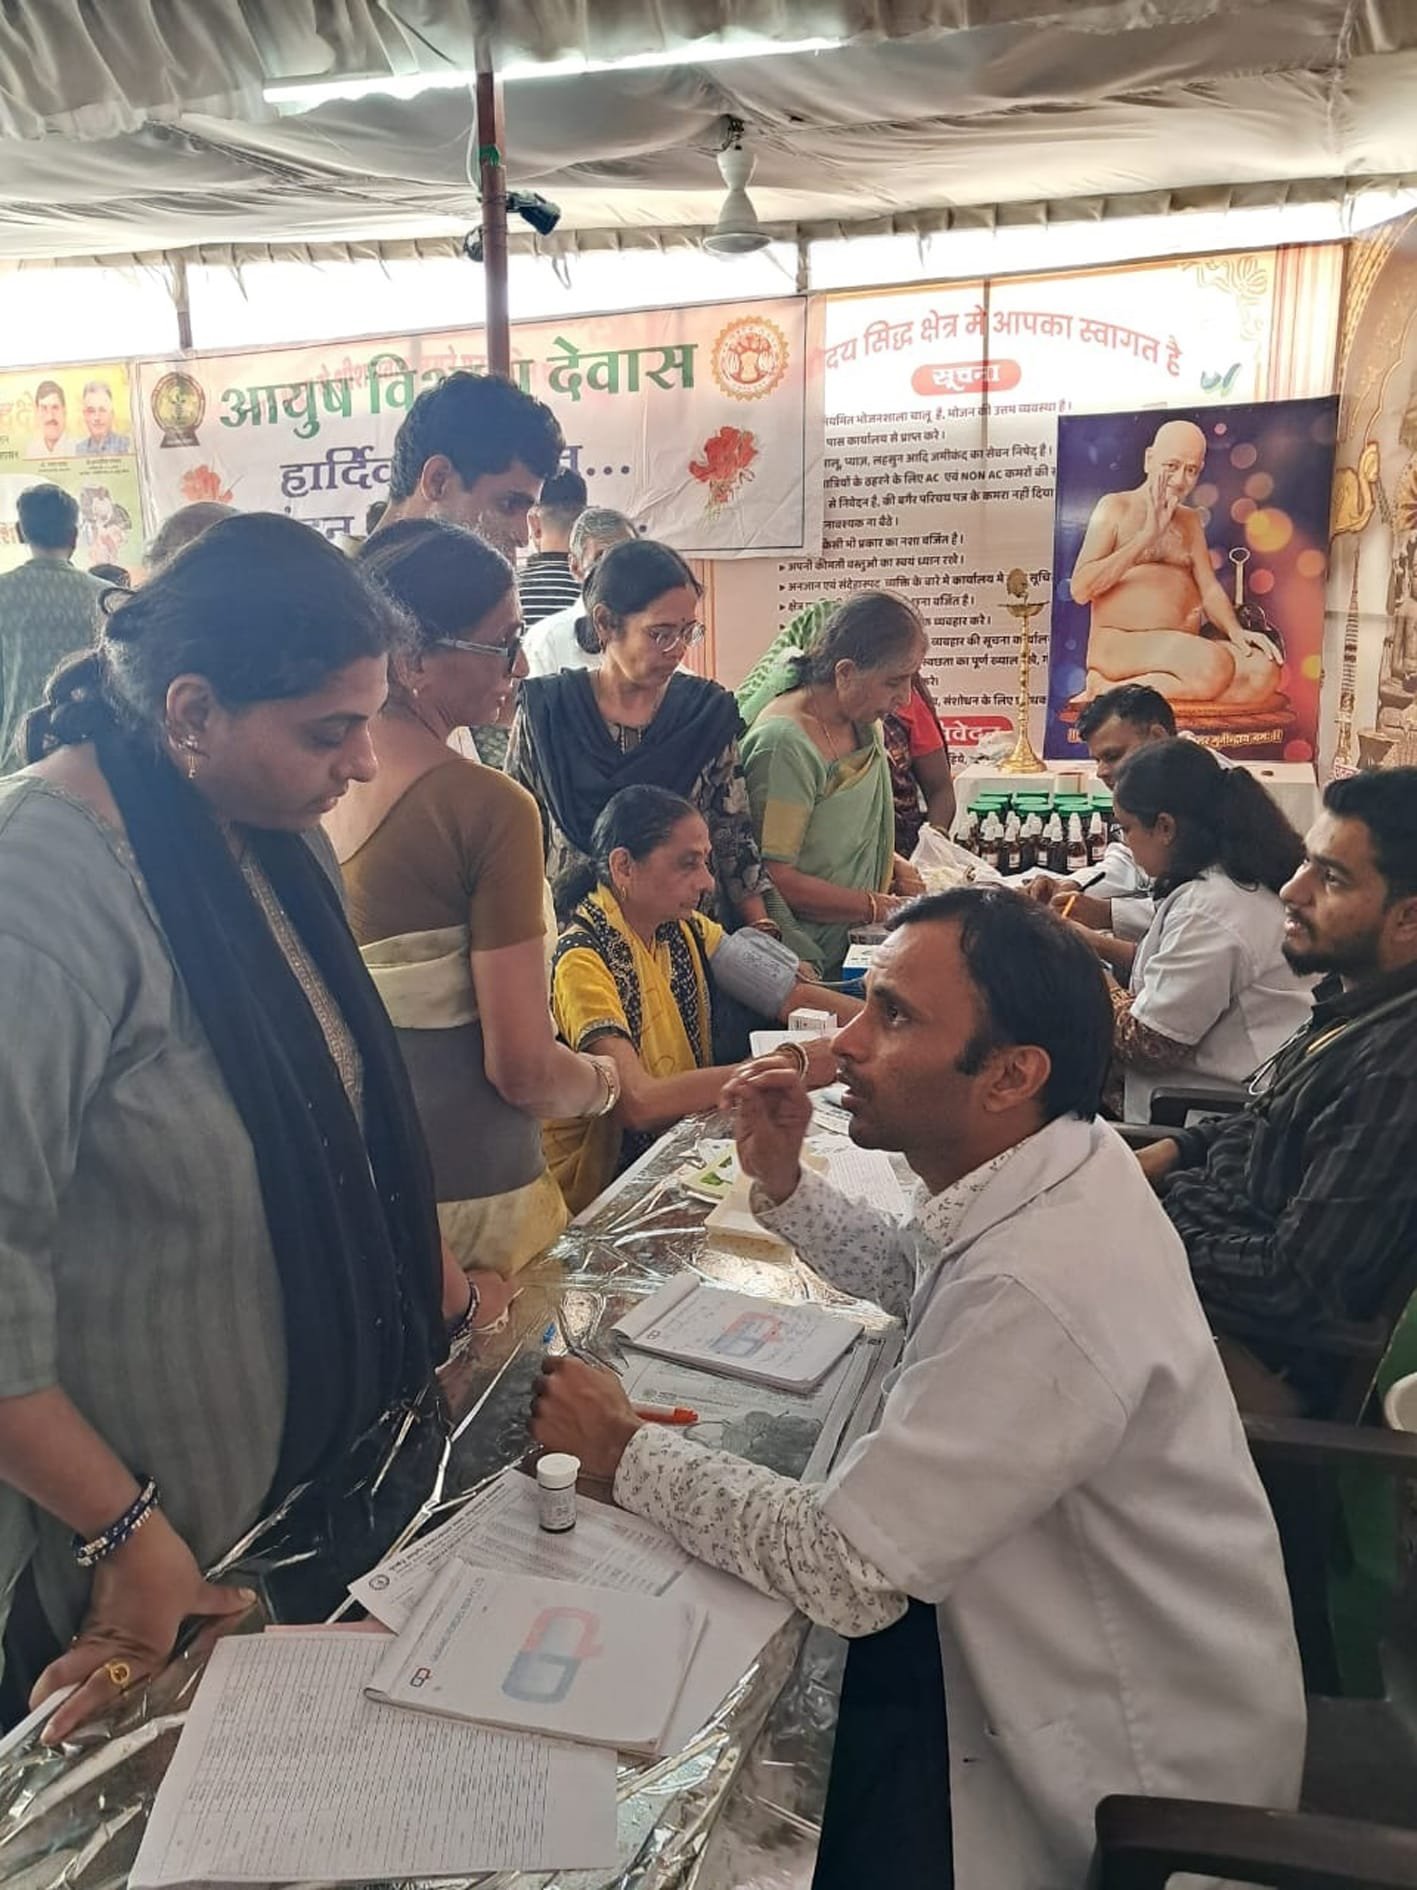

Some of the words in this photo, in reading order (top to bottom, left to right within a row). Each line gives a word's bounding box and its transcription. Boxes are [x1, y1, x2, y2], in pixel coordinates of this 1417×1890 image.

[825, 338, 858, 369] दय
[863, 320, 914, 356] सिद्ध
[921, 309, 959, 343] क्षेत्र
[993, 310, 1073, 339] आपका
[1079, 317, 1161, 364] स्वागत
[1166, 334, 1183, 377] है
[932, 365, 1001, 392] सूचना
[219, 376, 353, 438] आयुष
[548, 337, 698, 403] देवास
[825, 413, 854, 426] यमित
[856, 411, 908, 424] भोजनशाला
[910, 410, 932, 424] चालू
[948, 406, 975, 418] भोजन
[1018, 402, 1057, 414] व्यवस्था
[826, 437, 845, 447] पास
[847, 432, 887, 446] कार्यालय
[890, 430, 898, 443] से
[901, 431, 922, 442] प्राप्त
[873, 454, 904, 468] लहसुन
[906, 449, 929, 463] आदि
[970, 449, 983, 460] का
[986, 446, 1009, 458] सेवन
[823, 475, 851, 489] ात्रियों
[853, 475, 863, 487] के
[865, 473, 889, 488] ठहरने
[892, 473, 902, 485] के
[905, 471, 924, 484] लिए
[925, 474, 939, 483] AC
[944, 471, 959, 483] एवं
[961, 471, 986, 481] NON
[988, 470, 1002, 479] AC
[1005, 465, 1032, 479] कमरों
[1034, 463, 1049, 477] की
[828, 496, 837, 509] से
[839, 496, 869, 508] निवेदन
[882, 493, 895, 506] की
[919, 491, 951, 504] परिचय
[952, 492, 968, 502] पत्र
[970, 489, 980, 501] के
[982, 490, 1009, 501] कमरा
[1032, 485, 1054, 499] दिया
[866, 517, 876, 527] ना
[845, 536, 856, 548] भी
[858, 537, 883, 548] प्रकार
[885, 537, 898, 546] का
[900, 536, 920, 546] नशा
[922, 532, 949, 545] वर्जित
[788, 559, 813, 571] अपनी
[815, 558, 845, 570] कीमती
[880, 558, 893, 567] का
[918, 555, 940, 566] ध्यान
[788, 580, 822, 591] अनजान
[823, 579, 836, 590] एवं
[912, 575, 923, 587] के
[924, 573, 940, 586] बारे
[952, 572, 994, 585] कार्यालय
[1030, 569, 1051, 586] सूचि
[933, 593, 960, 606] वर्जित
[934, 615, 967, 628] व्यवहार
[931, 635, 965, 648] व्यवहार
[967, 632, 981, 646] की
[983, 635, 1011, 648] सूचना
[956, 655, 969, 666] का
[971, 654, 988, 669] पूर्ण
[991, 654, 1019, 666] ख्याल
[943, 692, 979, 706] संशोधन
[981, 694, 991, 705] के
[994, 692, 1014, 705] लिए
